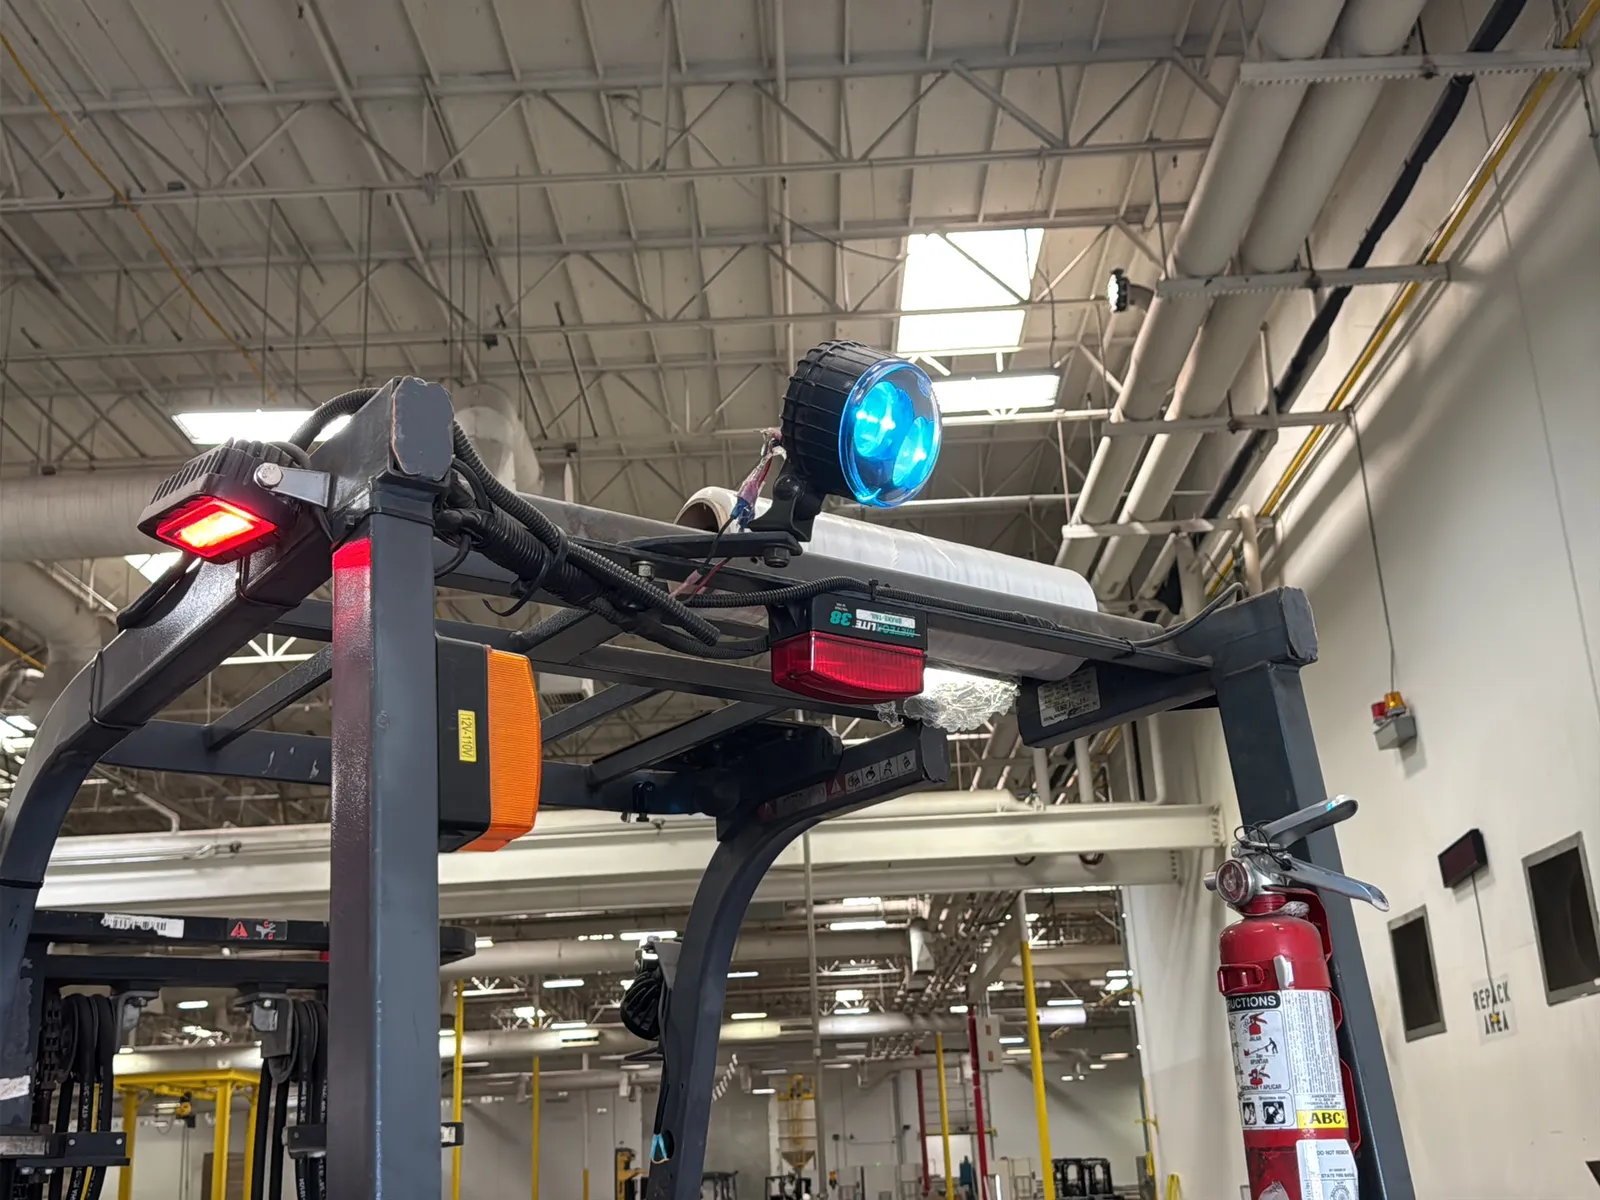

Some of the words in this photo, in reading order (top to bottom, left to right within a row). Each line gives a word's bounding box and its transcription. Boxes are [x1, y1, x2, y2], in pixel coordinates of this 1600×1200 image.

[830, 610, 852, 627] 38
[461, 717, 473, 757] 12V-110V
[1473, 981, 1511, 1012] REPACK
[1484, 1010, 1509, 1035] AREA
[1309, 1112, 1341, 1125] ABC
